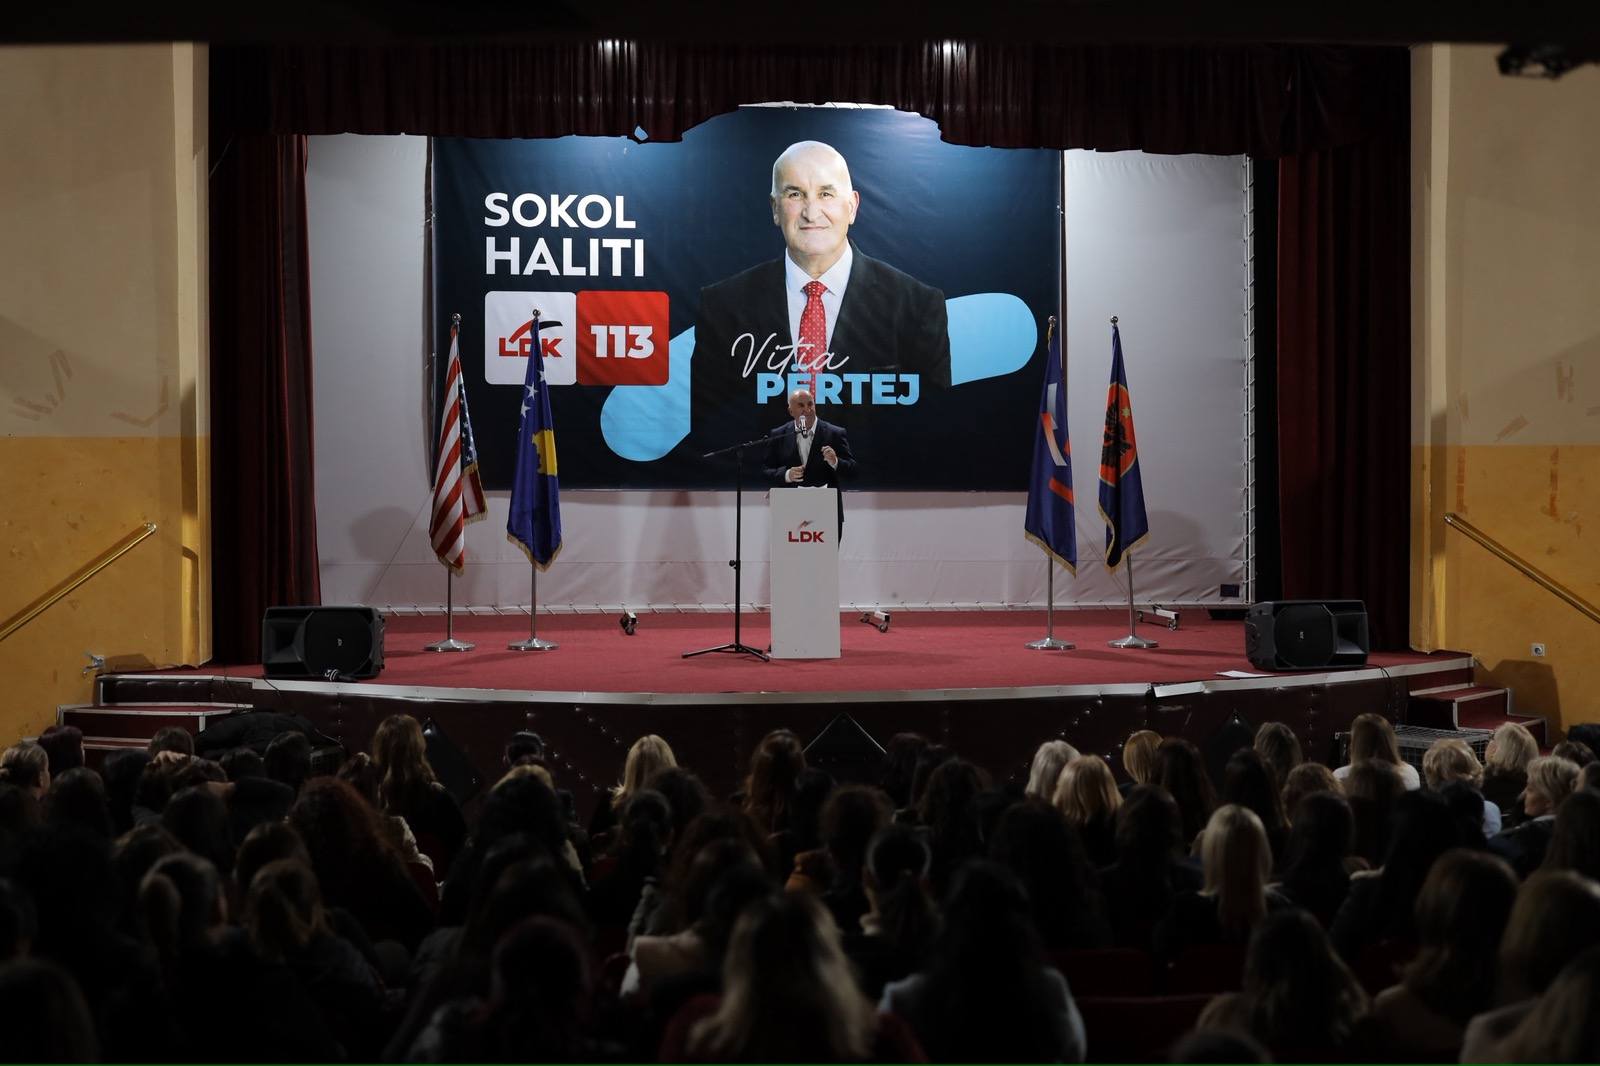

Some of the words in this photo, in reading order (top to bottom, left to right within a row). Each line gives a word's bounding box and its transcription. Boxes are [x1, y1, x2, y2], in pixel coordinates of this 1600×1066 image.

[484, 192, 636, 229] SOKOL
[485, 236, 644, 277] HALITI
[591, 325, 654, 359] 113
[731, 331, 850, 379] Vitia
[788, 530, 825, 543] LDK
